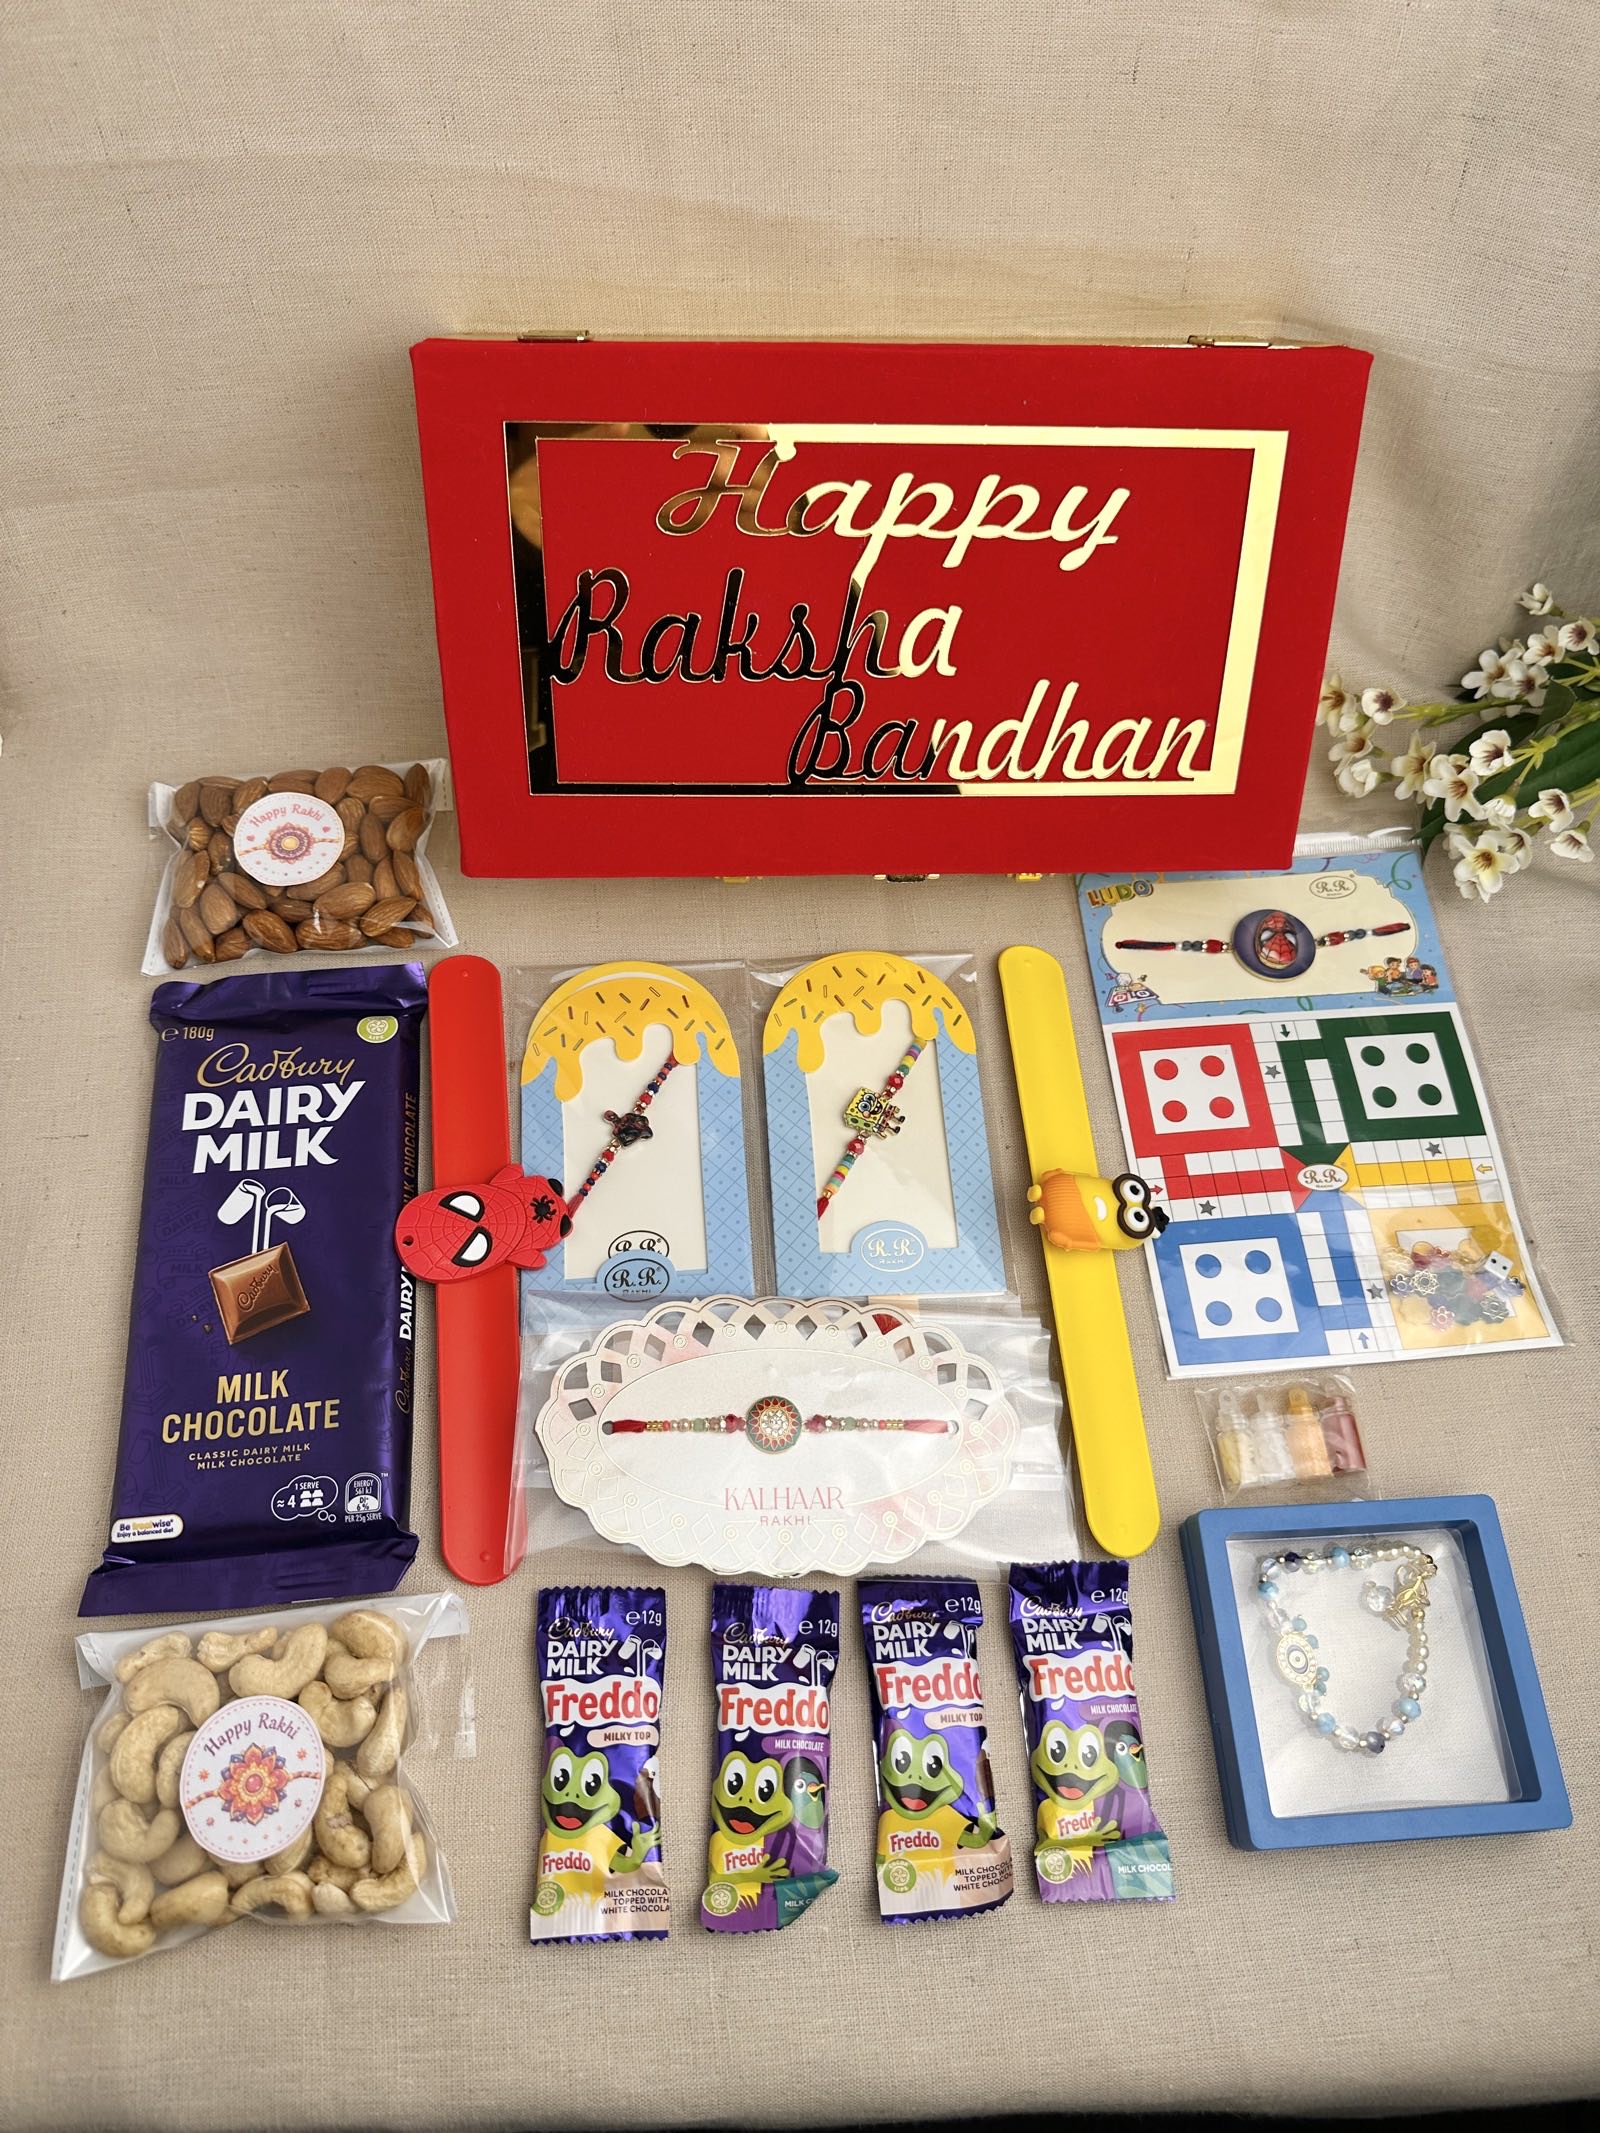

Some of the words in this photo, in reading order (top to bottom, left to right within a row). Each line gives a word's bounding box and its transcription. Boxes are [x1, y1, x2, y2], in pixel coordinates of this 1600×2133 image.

[656, 438, 1130, 571] Happy
[549, 567, 959, 686] Raksha
[789, 680, 1206, 782] Bandhan
[249, 807, 287, 827] Happy
[291, 803, 325, 822] Rakhi
[1086, 879, 1154, 908] LUDO
[183, 1027, 215, 1041] 180g
[196, 1042, 356, 1088] Cadbury
[181, 1080, 366, 1131] DAIRY
[403, 1092, 417, 1178] CHOCOLATE
[192, 1126, 340, 1174] MILK
[237, 1263, 278, 1312] Cadbury
[400, 1272, 414, 1341] DAIRY
[216, 1369, 290, 1405] MILK
[161, 1399, 341, 1444] CHOCOLATE
[188, 1449, 240, 1461] CLASSIC
[243, 1446, 279, 1457] DAIRY
[282, 1442, 311, 1453] MILK
[197, 1459, 226, 1470] MILK
[230, 1454, 302, 1467] CHOCOLATE
[300, 1481, 319, 1490] SERVE
[353, 1480, 374, 1488] ENERGY
[724, 1486, 844, 1511] KALHAAR
[119, 1523, 131, 1532] Be
[345, 1514, 354, 1523] PER
[355, 1513, 366, 1524] 25g
[366, 1512, 382, 1521] SERVE
[760, 1515, 812, 1526] RAKHI
[1110, 1588, 1128, 1605] 12g
[871, 1601, 937, 1624] Cadbury
[548, 1616, 615, 1640] Cadbury
[723, 1621, 790, 1648] Cadbury
[818, 1619, 838, 1638] 12g
[873, 1621, 941, 1641] DAIRY
[1022, 1617, 1088, 1633] DAIRY
[547, 1640, 618, 1658] DAIRY
[875, 1639, 933, 1660] MILK
[1025, 1632, 1083, 1652] MILK
[723, 1645, 793, 1663] DAIRY
[546, 1657, 604, 1677] MILK
[723, 1662, 779, 1681] MILK
[546, 1680, 658, 1722] Freddo
[721, 1687, 829, 1729] Freddo
[1090, 1704, 1105, 1714] MILK
[940, 1713, 967, 1723] MILKY
[969, 1712, 983, 1722] TOP
[203, 1719, 252, 1757] Happy
[258, 1712, 301, 1740] Rakhi
[603, 1732, 633, 1742] MILKY
[634, 1731, 651, 1741] TOP
[774, 1739, 791, 1749] MILK
[792, 1739, 825, 1752] CHOCOLATE
[889, 1831, 940, 1852] Freddo
[542, 1851, 591, 1874] Freddo
[1118, 1864, 1137, 1874] MILK
[955, 1868, 977, 1877] MILK
[964, 1873, 997, 1883] TOPPED
[603, 1889, 624, 1898] MILK
[626, 1888, 668, 1897] CHOCOLA
[953, 1882, 981, 1892] WHITE
[600, 1905, 628, 1914] WHITE
[613, 1897, 646, 1906] TOPPED
[647, 1896, 669, 1904] WITH
[784, 1899, 805, 1907] MILK
